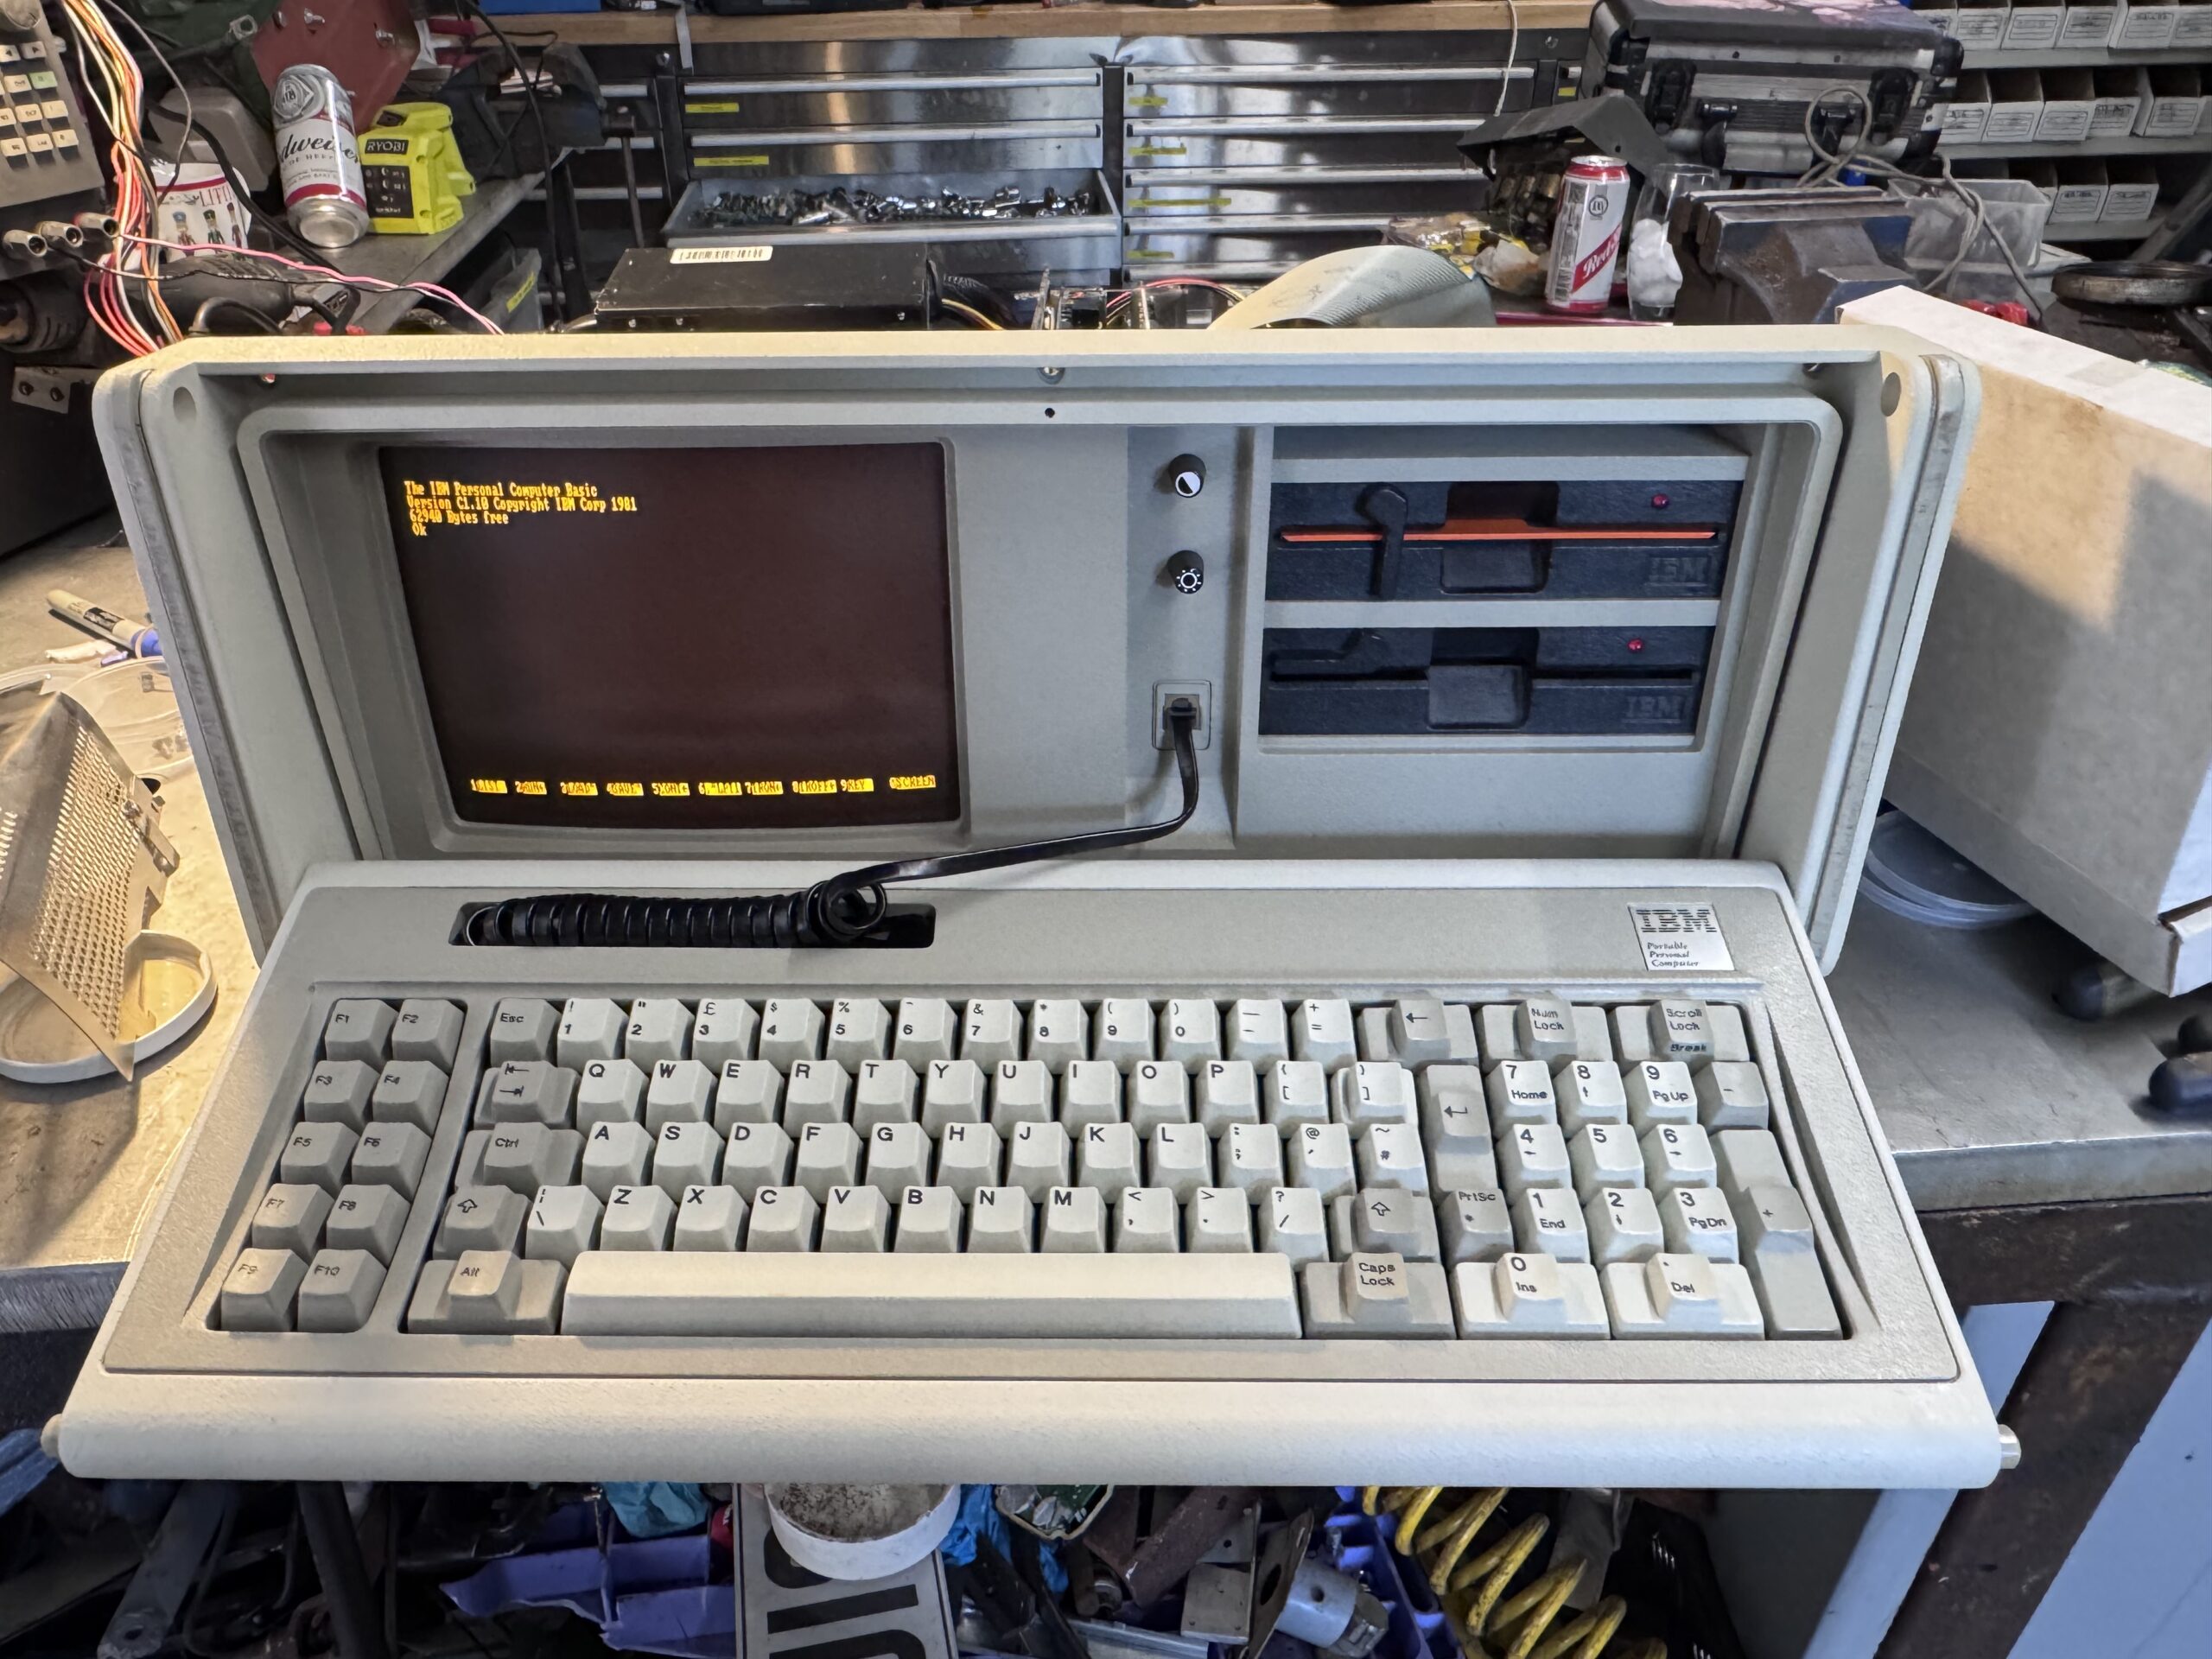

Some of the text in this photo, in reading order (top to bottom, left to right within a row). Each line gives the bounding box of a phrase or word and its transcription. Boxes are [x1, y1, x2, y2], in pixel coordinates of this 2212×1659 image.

[367, 141, 404, 152] RYOBI
[404, 480, 598, 498] The IBM Personal Computer Basic
[407, 495, 638, 513] Version C1.10 Copyright IBM Corp 1981
[448, 511, 478, 525] Bytes
[411, 524, 427, 537] Ok
[1648, 557, 1709, 583] IBM
[1626, 696, 1683, 719] IBM
[1636, 909, 1717, 932] IBM
[1647, 941, 1687, 950] Portable
[1651, 959, 1699, 968] Computer
[703, 1002, 715, 1015] £
[770, 1002, 778, 1013] $
[838, 1001, 849, 1013] %
[973, 1003, 983, 1015] &
[1309, 1003, 1319, 1012] +
[1531, 1008, 1559, 1019] Num
[1666, 1008, 1702, 1018] Scroll
[335, 1014, 349, 1023] F1
[402, 1014, 419, 1024] F2
[500, 1013, 524, 1023] Esc
[631, 1024, 642, 1035] 2
[699, 1025, 709, 1035] 3
[766, 1025, 777, 1035] 4
[836, 1024, 845, 1035] 5
[903, 1024, 912, 1035] 6
[972, 1025, 981, 1036] 7
[1108, 1025, 1117, 1036] 9
[1534, 1020, 1565, 1030] Lock
[1669, 1021, 1700, 1031] Lock
[1039, 1027, 1049, 1037] 8
[588, 1064, 606, 1077] Q
[660, 1063, 677, 1078] W
[727, 1063, 741, 1078] E
[795, 1063, 810, 1078] R
[865, 1064, 880, 1078] T
[935, 1064, 949, 1078] Y
[1002, 1065, 1016, 1079] U
[1141, 1065, 1157, 1079] O
[1211, 1064, 1224, 1078] P
[1505, 1065, 1517, 1079] 7
[1577, 1065, 1591, 1079] 8
[1646, 1065, 1660, 1080] 9
[1362, 1086, 1370, 1101] ]
[1511, 1090, 1548, 1099] Home
[594, 1125, 609, 1141] A
[665, 1126, 680, 1141] S
[734, 1125, 750, 1141] D
[806, 1126, 821, 1141] F
[877, 1127, 893, 1141] G
[949, 1125, 964, 1141] H
[1020, 1127, 1031, 1140] J
[1090, 1127, 1104, 1142] K
[1161, 1127, 1174, 1142] L
[1306, 1128, 1320, 1140] @
[1520, 1128, 1534, 1143] 4
[1592, 1128, 1607, 1143] 5
[1663, 1128, 1678, 1143] 6
[293, 1136, 312, 1147] F5
[364, 1137, 381, 1147] F6
[495, 1138, 519, 1147] Ctrl
[613, 1188, 632, 1205] Z
[687, 1188, 704, 1205] X
[760, 1189, 777, 1205] C
[835, 1189, 850, 1205] V
[908, 1189, 923, 1205] B
[980, 1190, 995, 1205] N
[1054, 1190, 1071, 1206] M
[1128, 1192, 1141, 1201] <
[1201, 1191, 1215, 1199] >
[1275, 1191, 1284, 1202] ?
[1533, 1192, 1543, 1208] 1
[1608, 1192, 1624, 1207] 2
[1680, 1192, 1695, 1207] 3
[265, 1198, 285, 1208] F7
[339, 1200, 357, 1211] F8
[536, 1211, 544, 1226] \
[1279, 1215, 1289, 1228] /
[1540, 1218, 1566, 1229] End
[1688, 1217, 1727, 1229] PgDn
[238, 1263, 258, 1274] F9
[314, 1264, 340, 1276] F10
[460, 1267, 480, 1277] Alt
[1358, 1262, 1395, 1274] Caps
[1360, 1274, 1395, 1286] Lock
[1516, 1281, 1537, 1293] Ins
[1671, 1281, 1695, 1293] Del
